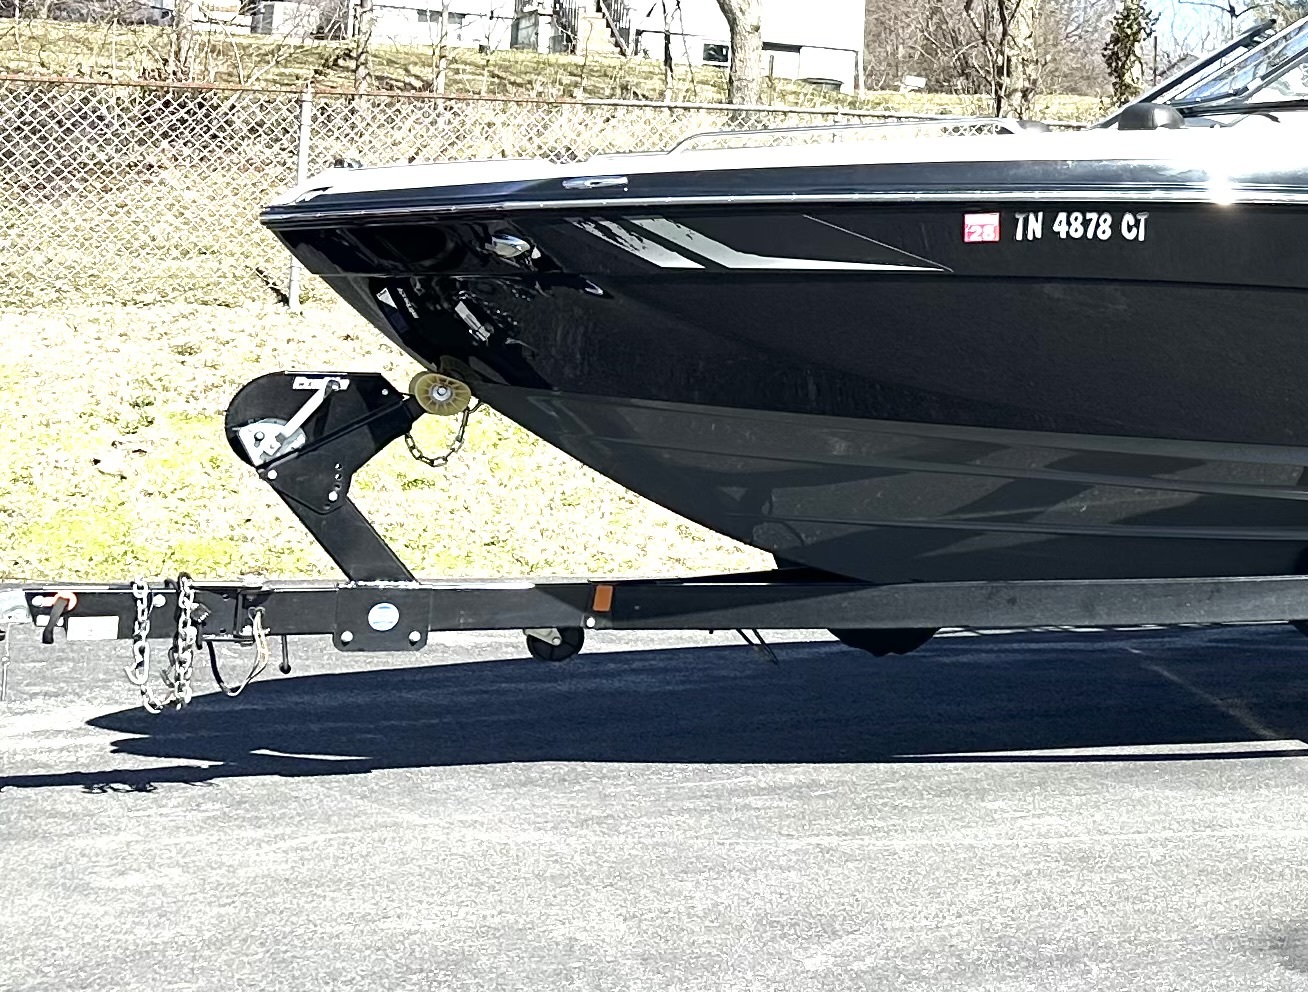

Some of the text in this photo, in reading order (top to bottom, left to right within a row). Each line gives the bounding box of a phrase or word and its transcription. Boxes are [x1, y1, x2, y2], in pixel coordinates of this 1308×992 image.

[1014, 211, 1150, 242] TN 4878 CT
